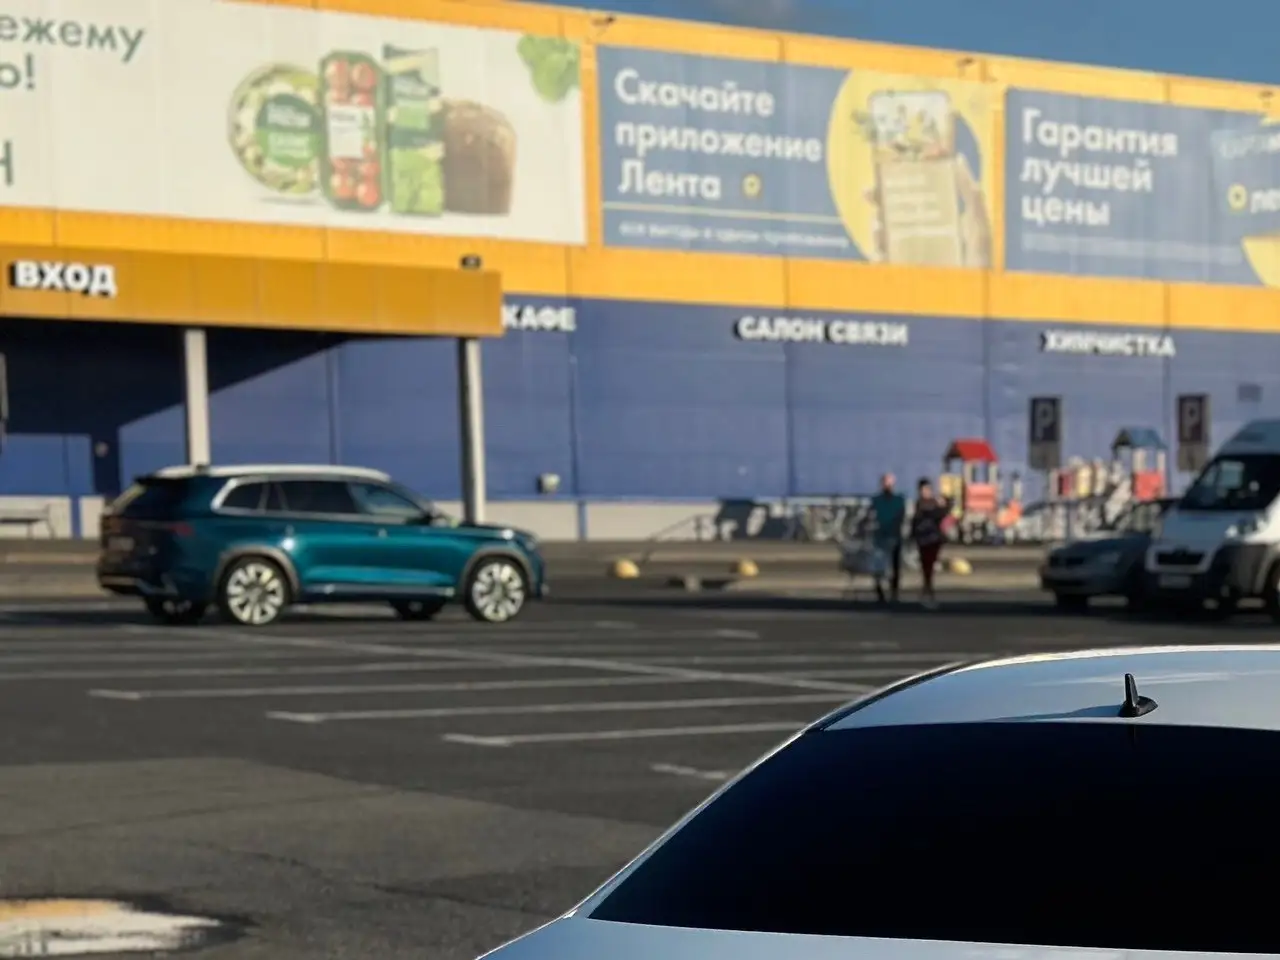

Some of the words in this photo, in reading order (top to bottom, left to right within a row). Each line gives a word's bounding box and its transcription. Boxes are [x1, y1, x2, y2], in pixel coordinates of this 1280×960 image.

[0, 14, 145, 64] ежему
[614, 68, 775, 118] Скачайте
[616, 121, 823, 163] приложение
[1021, 107, 1178, 158] Гарантия
[618, 159, 721, 199] Лента
[1020, 157, 1153, 194] лучшей
[1021, 195, 1110, 227] цены
[14, 260, 117, 297] ВХОД
[502, 304, 577, 332] КАФЕ
[736, 316, 825, 343] САЛОН
[829, 319, 907, 346] СВЯЗИ
[1043, 329, 1176, 358] ХИМЧИСТКА
